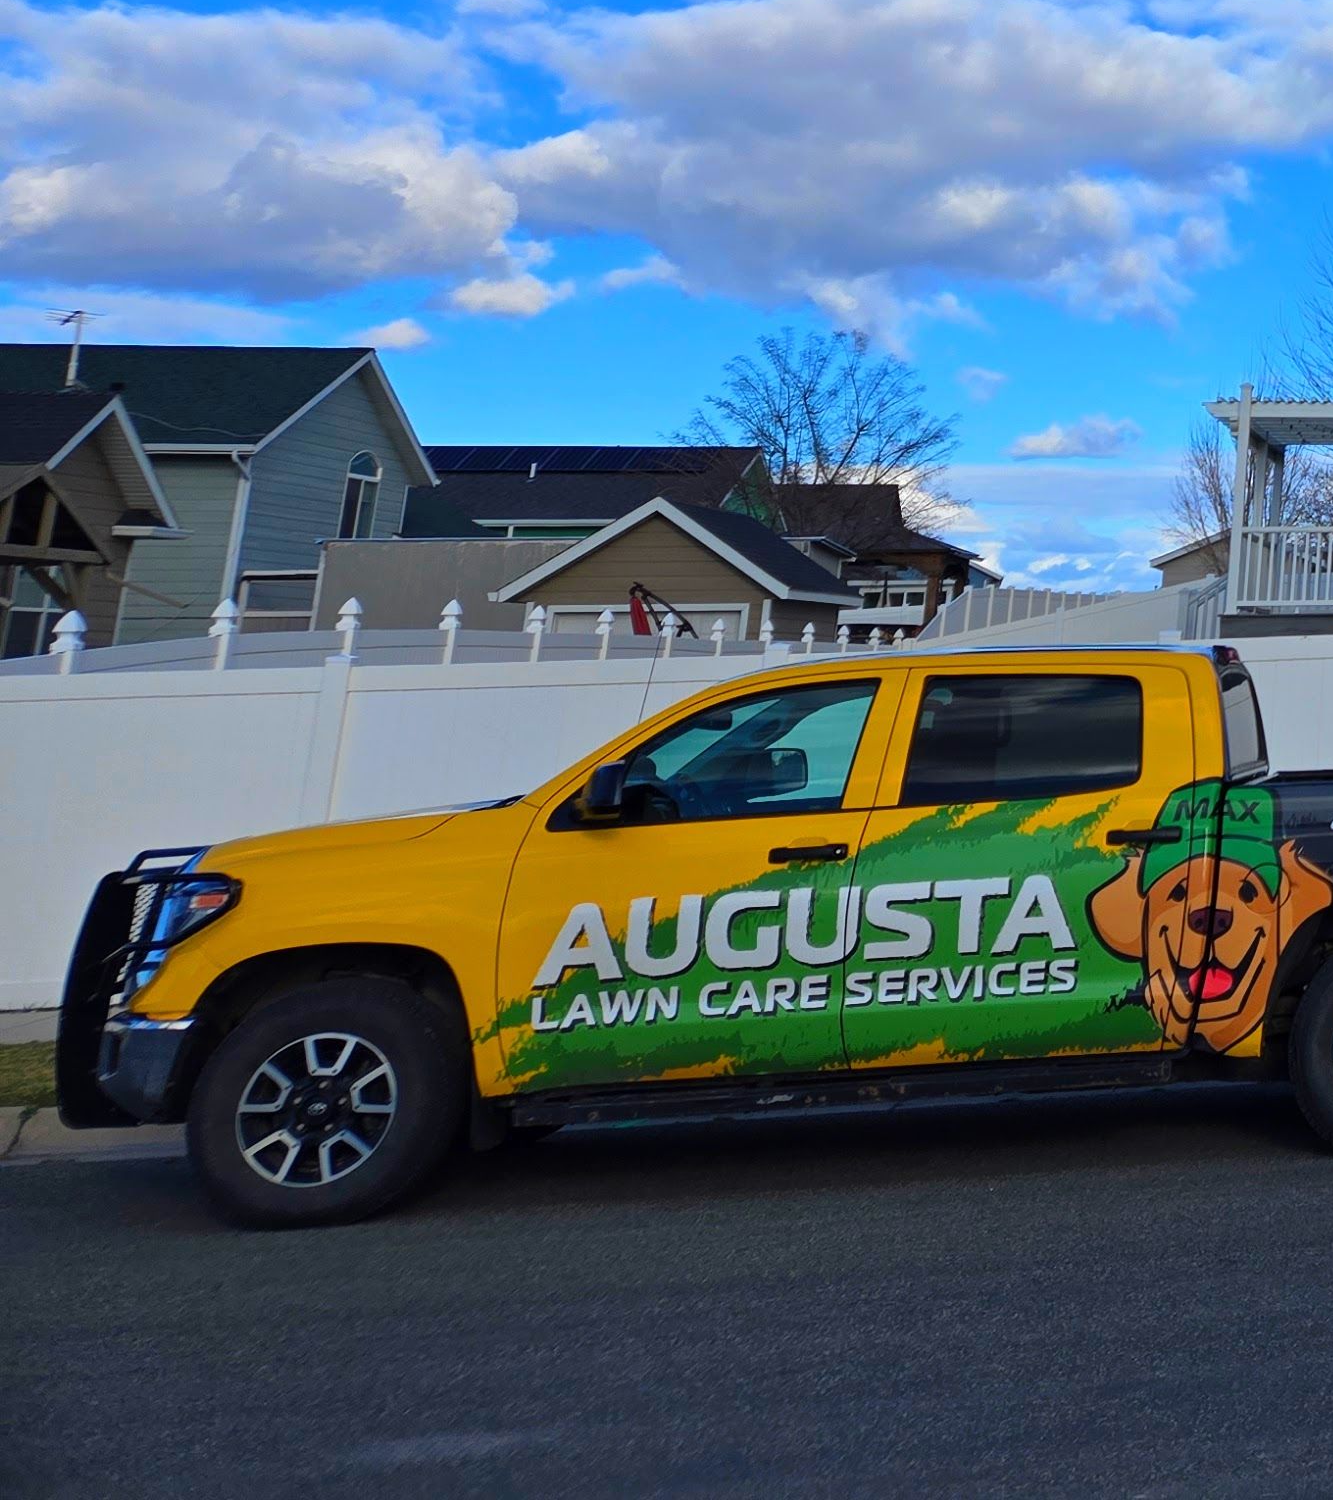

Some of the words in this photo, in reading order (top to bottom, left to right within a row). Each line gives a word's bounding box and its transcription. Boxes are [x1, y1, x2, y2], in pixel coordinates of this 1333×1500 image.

[1173, 798, 1261, 825] MAX
[532, 874, 1076, 987] AUGUSTA
[530, 986, 680, 1033] LAWN
[697, 975, 830, 1017] CARE
[844, 959, 1077, 1007] SERVICES
